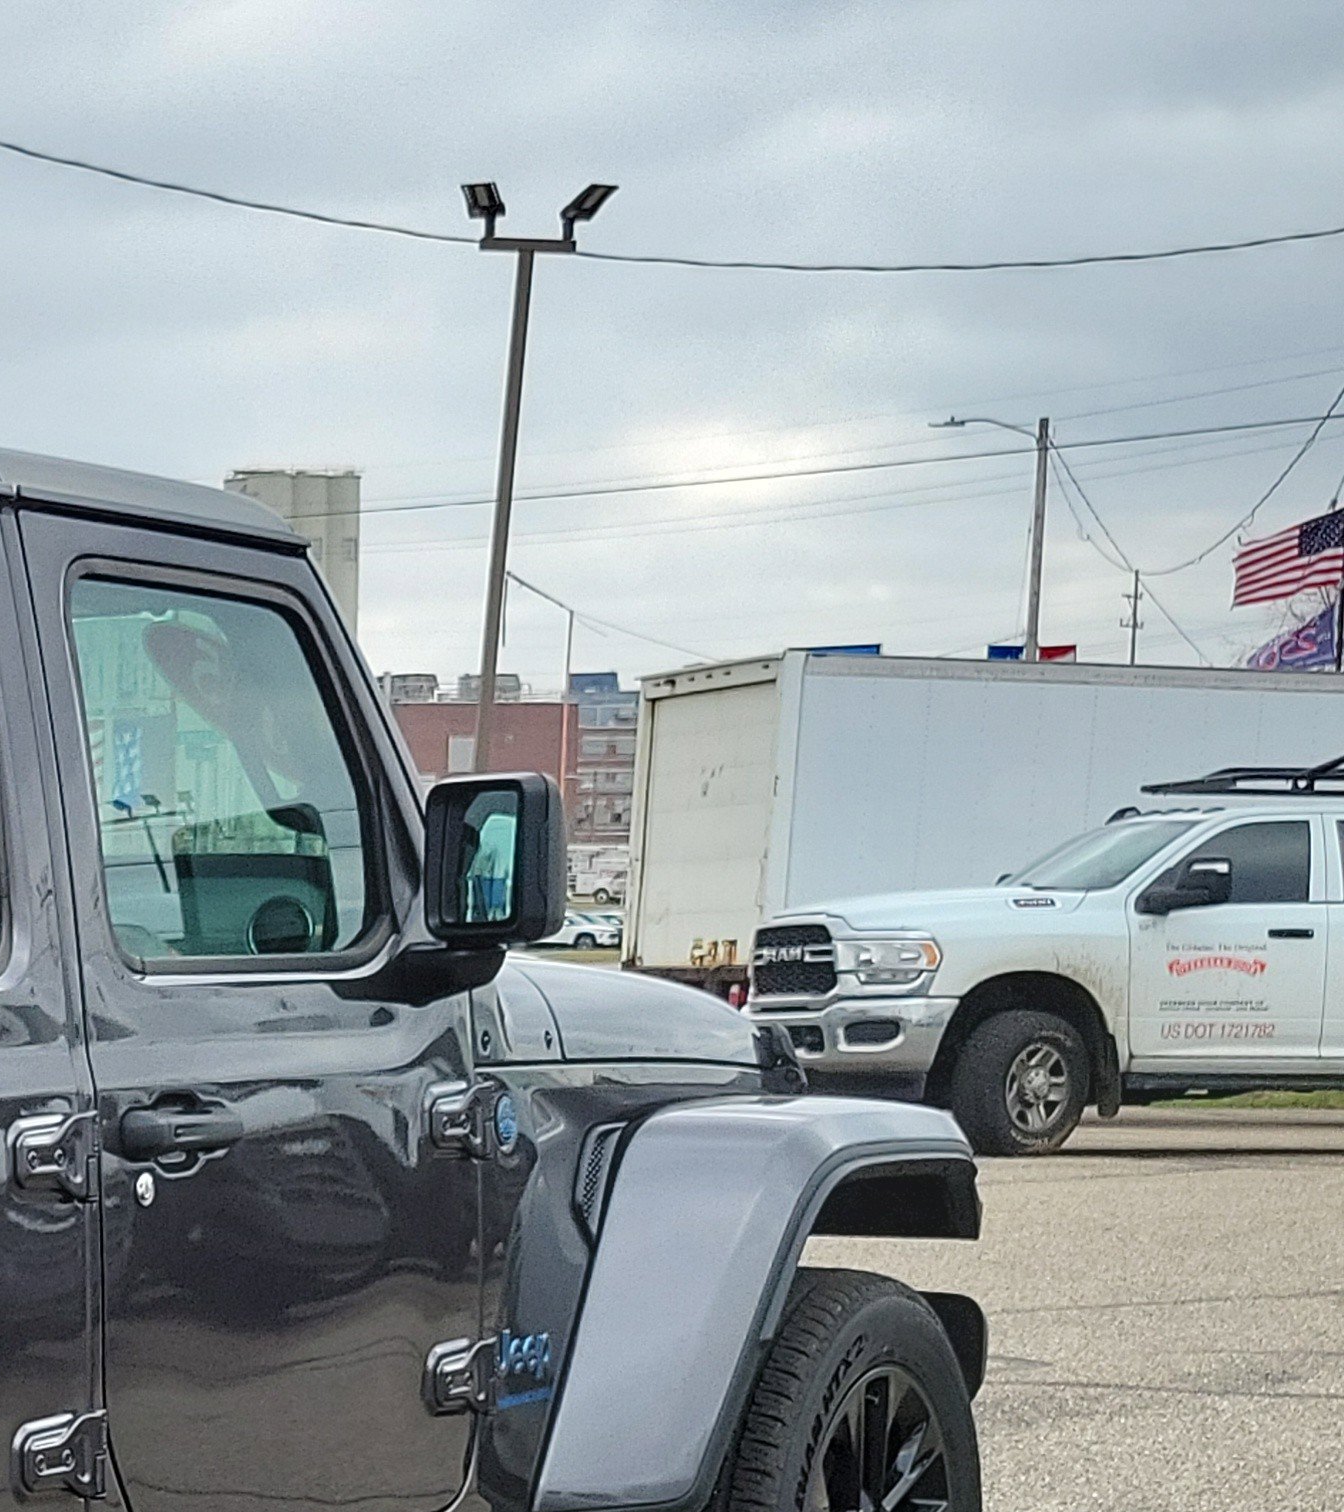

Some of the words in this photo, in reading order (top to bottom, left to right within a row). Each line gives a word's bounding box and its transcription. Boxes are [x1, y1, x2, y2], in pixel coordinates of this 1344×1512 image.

[1161, 1023, 1181, 1039] US
[1184, 1023, 1214, 1039] DOT
[497, 1328, 550, 1379] Jeep
